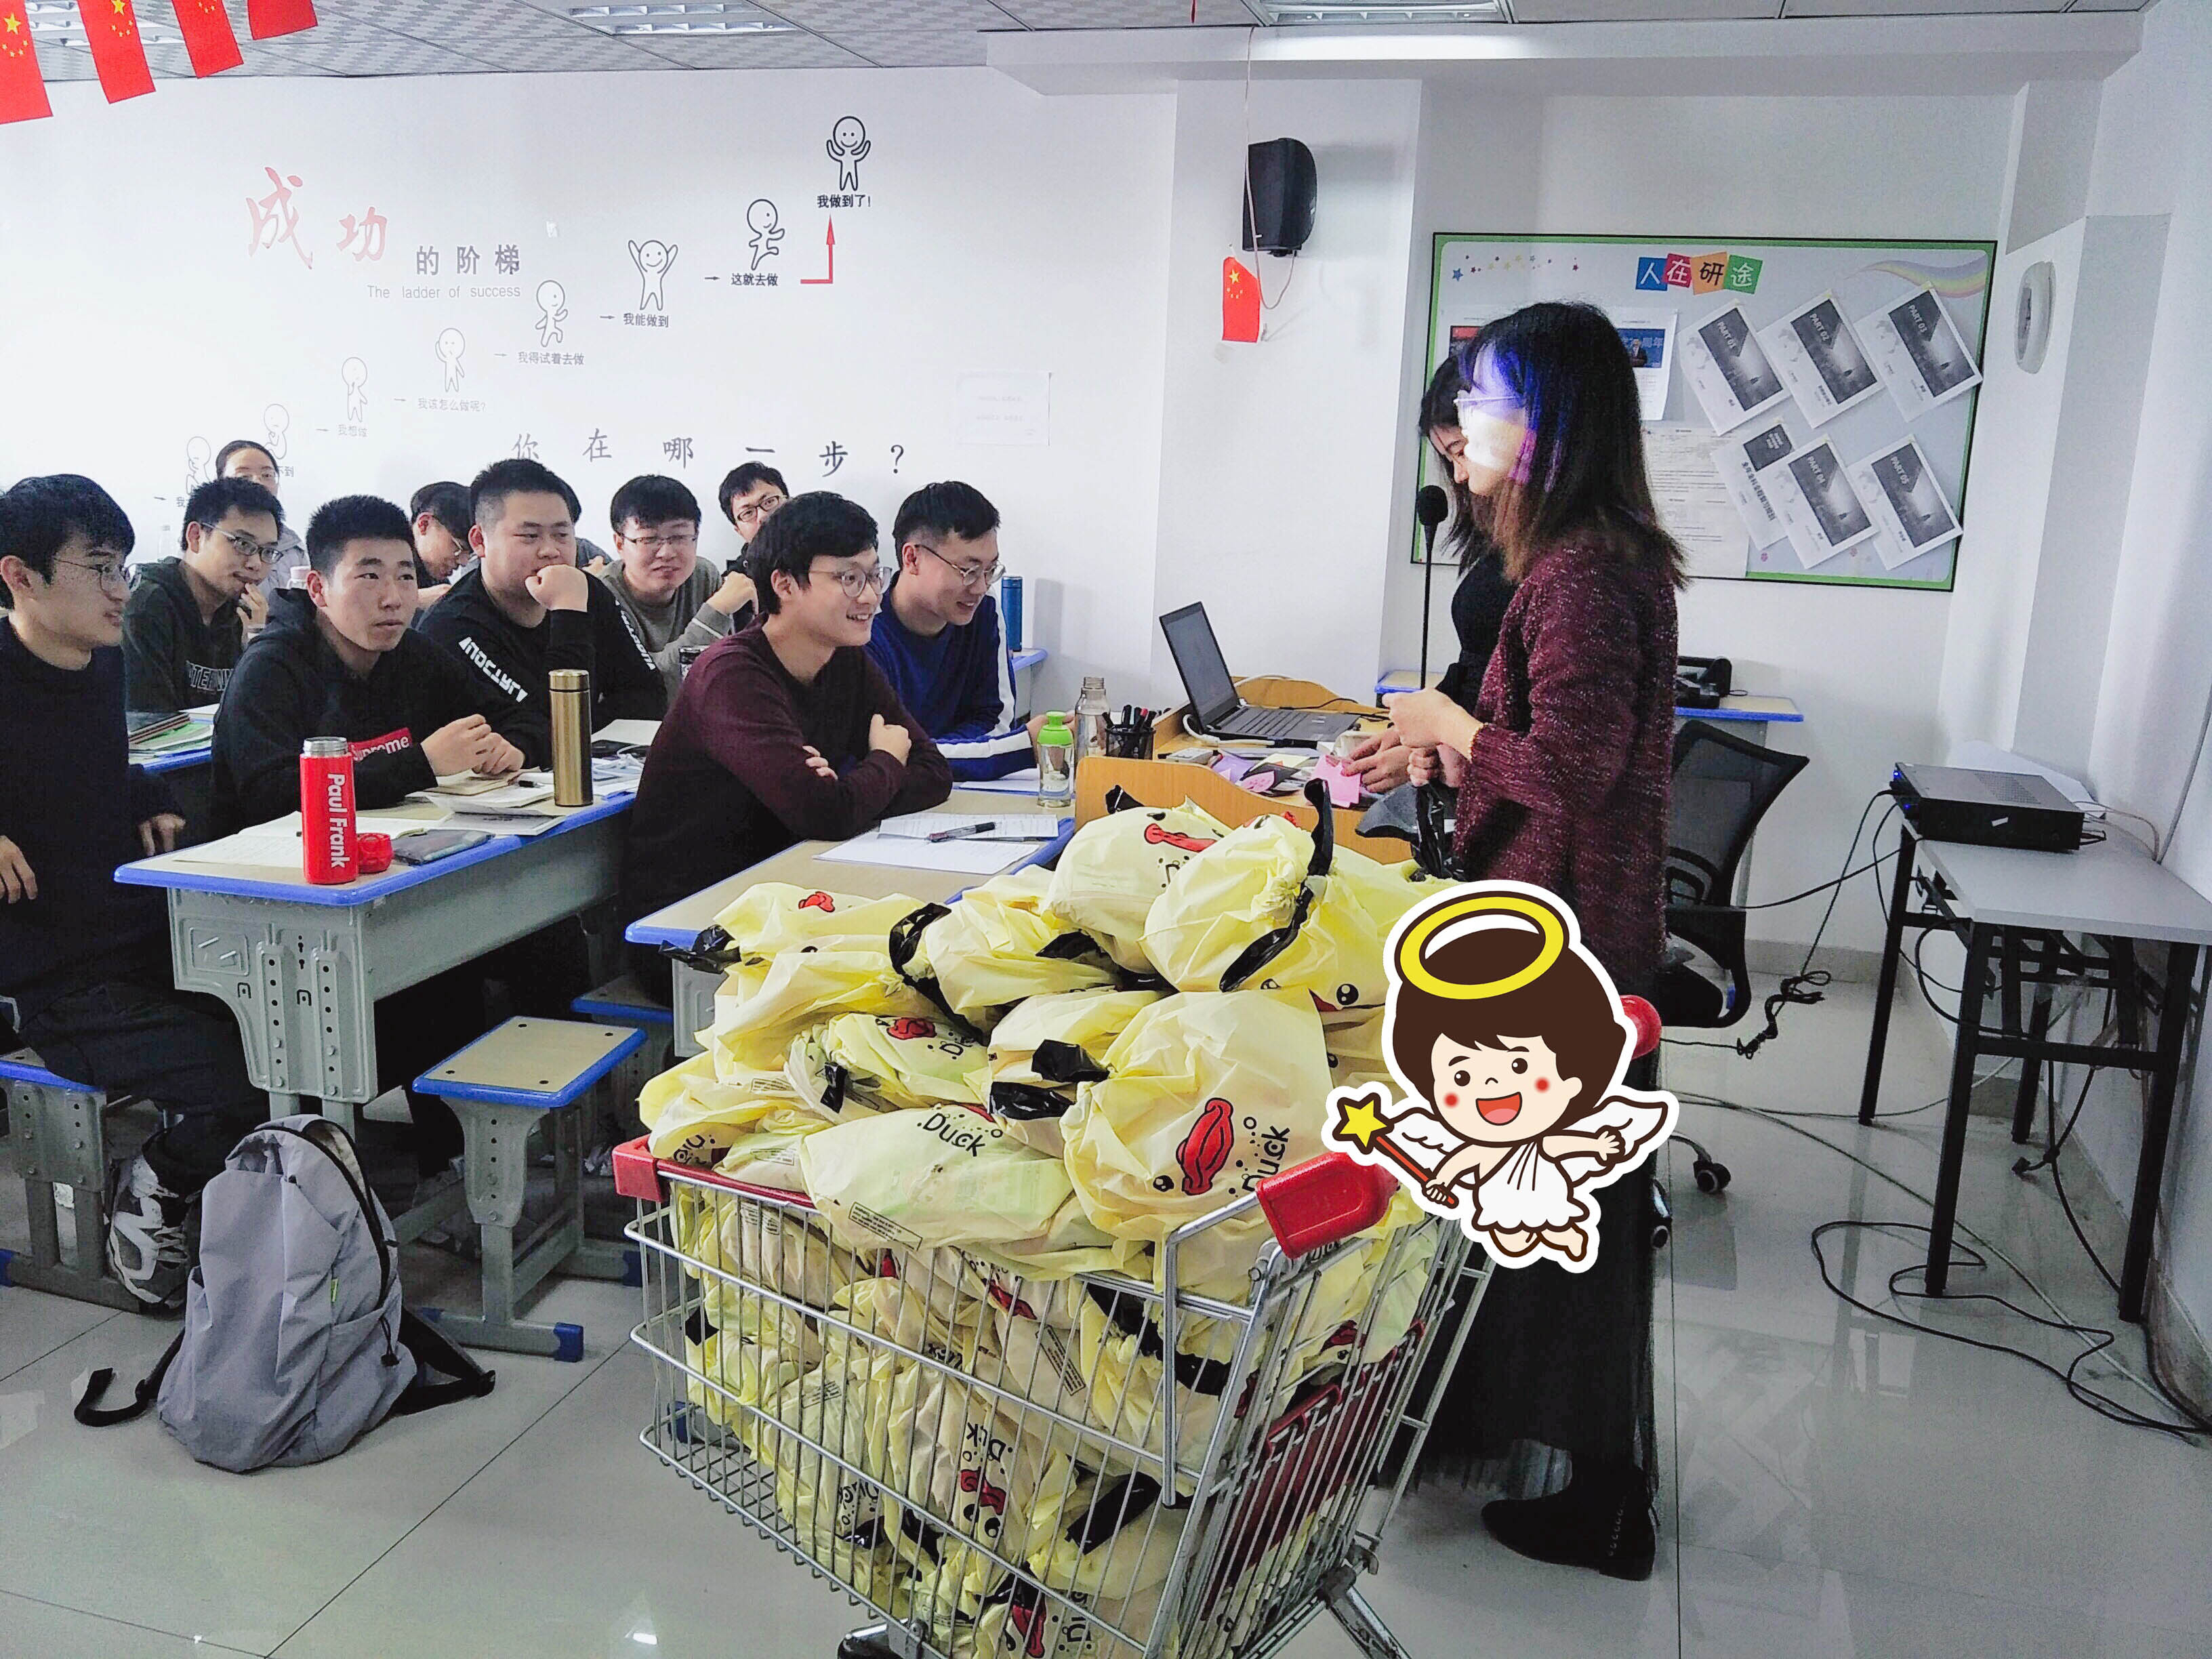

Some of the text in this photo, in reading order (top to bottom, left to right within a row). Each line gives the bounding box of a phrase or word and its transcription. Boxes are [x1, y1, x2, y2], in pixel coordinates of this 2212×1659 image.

[817, 194, 871, 209] 我做到了!
[416, 244, 520, 275] 的阶梯
[731, 272, 779, 287] 这就去做
[1640, 258, 1755, 288] 人在研途
[367, 285, 521, 300] The ladder of success
[623, 312, 669, 328] 我能做到
[1809, 312, 1824, 332] PART
[1908, 304, 1923, 323] PART
[518, 352, 584, 366] 我得试着去做
[1889, 455, 1906, 475] PART
[327, 773, 350, 868] Paul Frank
[922, 1113, 985, 1157] Duck
